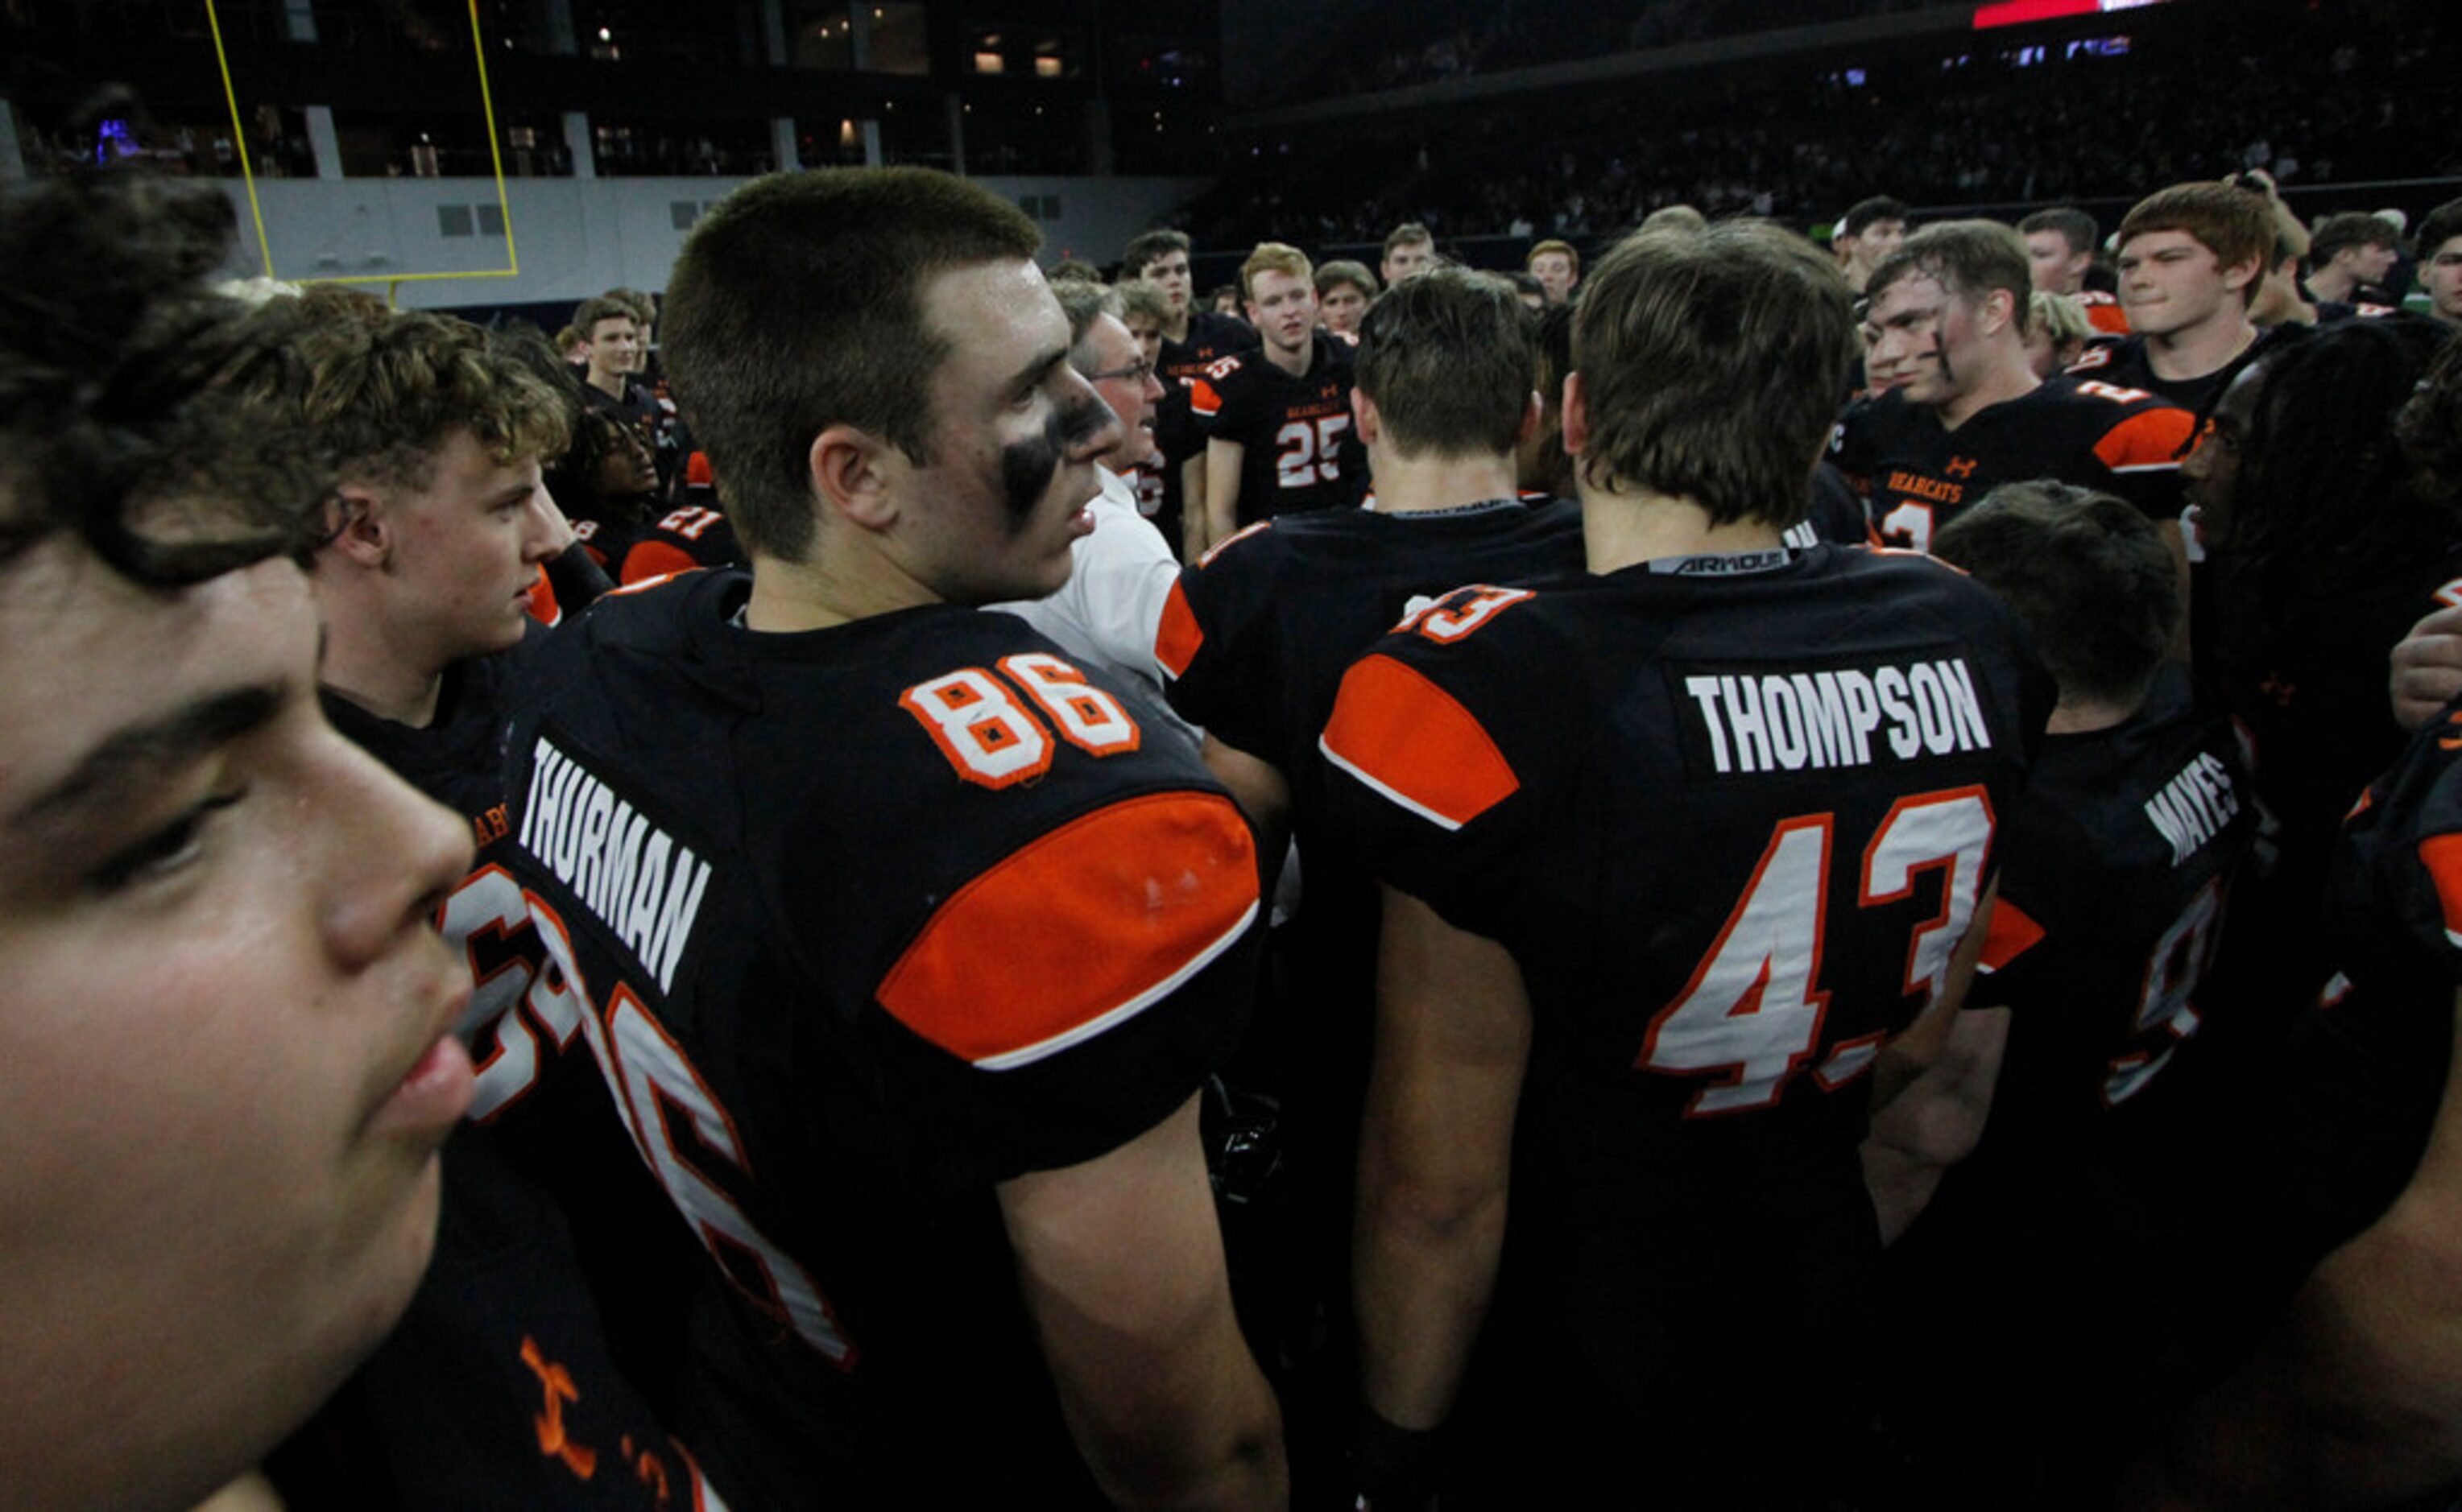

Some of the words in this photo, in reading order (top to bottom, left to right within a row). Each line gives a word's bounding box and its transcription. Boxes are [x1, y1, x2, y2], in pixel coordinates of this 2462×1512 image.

[1276, 411, 1350, 489] 25
[1887, 471, 1963, 503] BEARCATS
[656, 505, 723, 541] 21
[1674, 551, 1782, 574] ARMOUR
[897, 652, 1141, 791] 86
[1685, 658, 1992, 773] THOMPSON
[2144, 750, 2241, 868] MAYES
[519, 737, 713, 998] THURMAN
[1632, 783, 1997, 1120] 43
